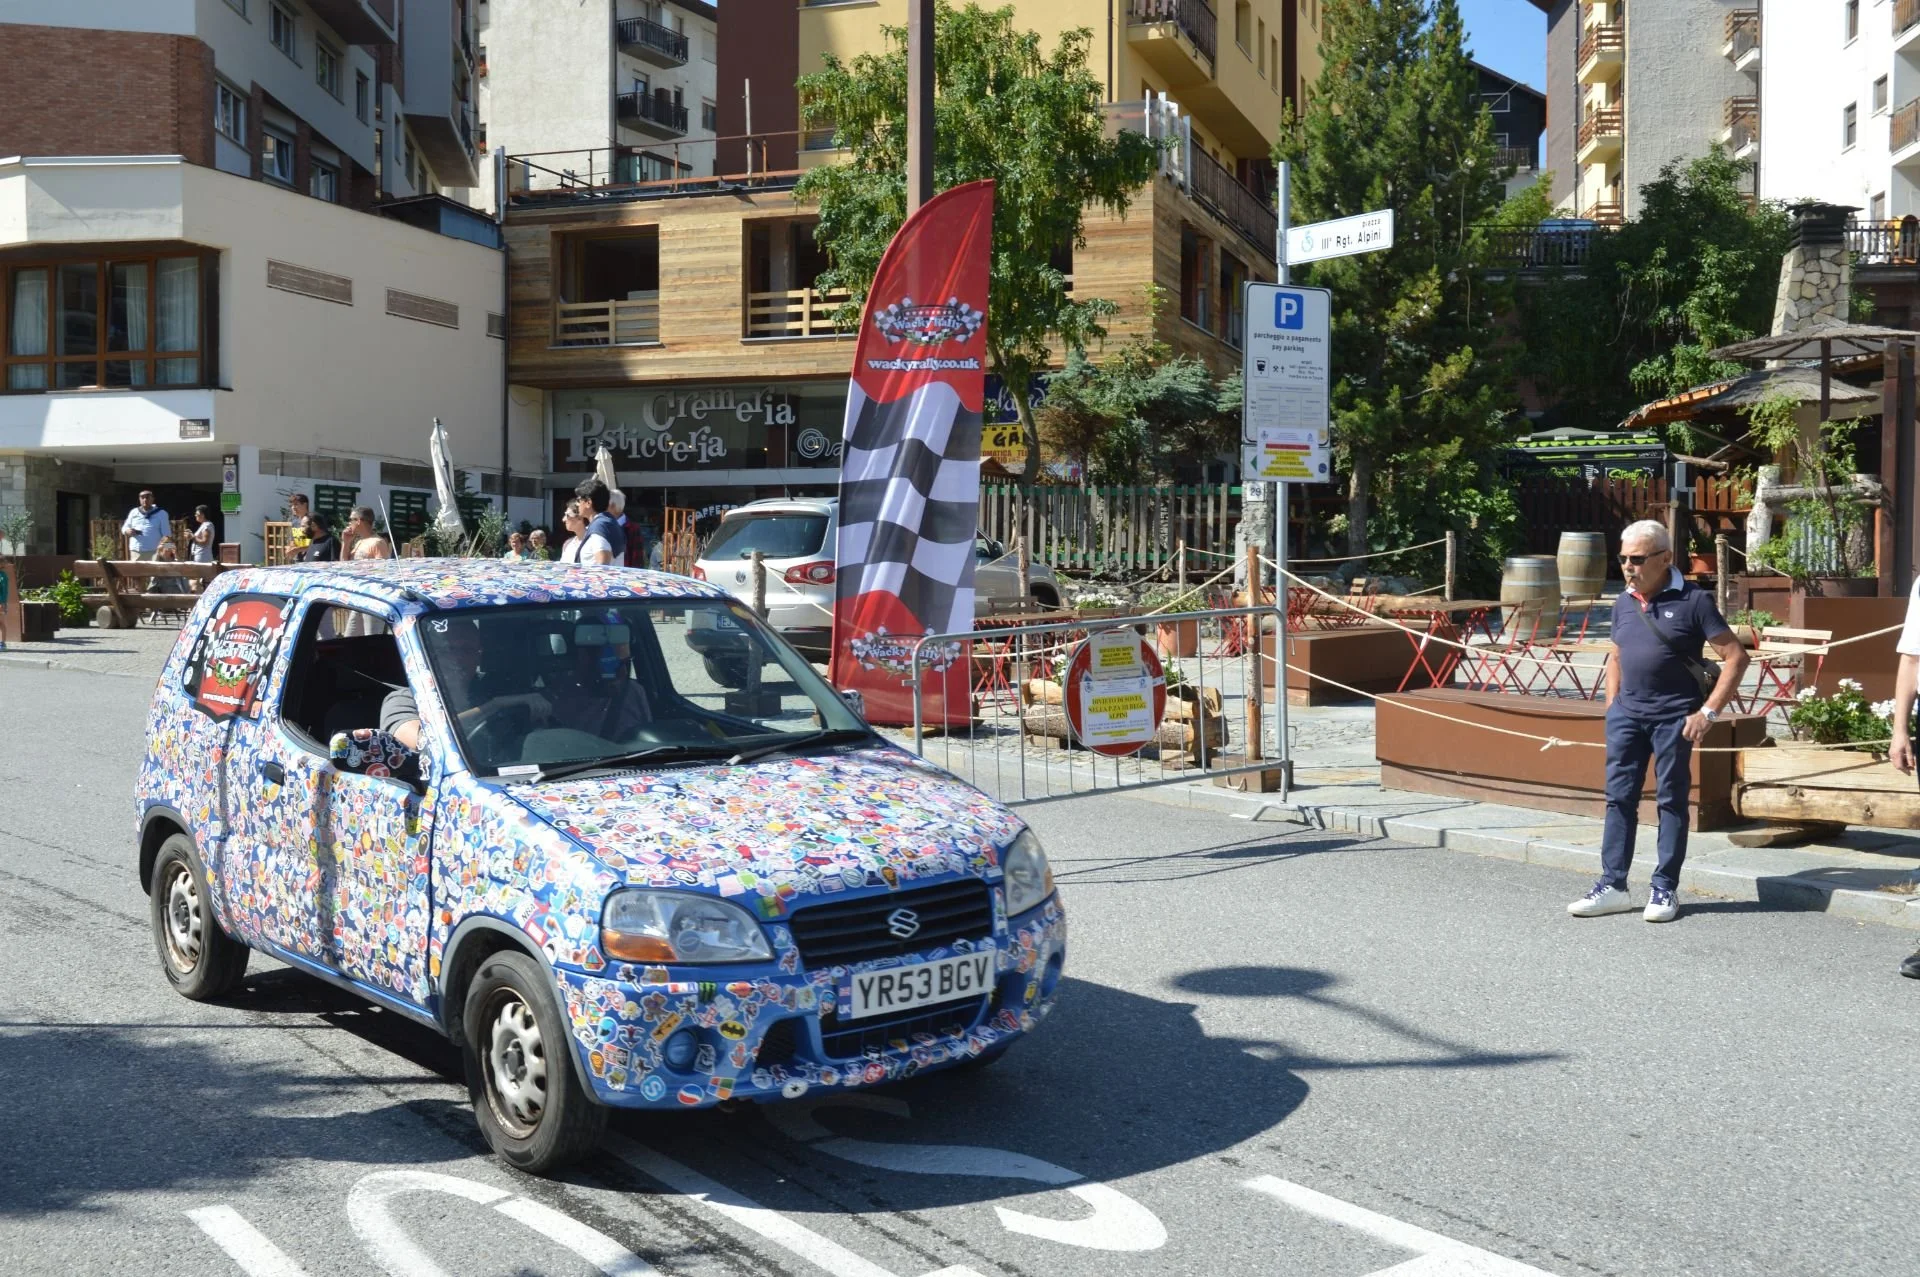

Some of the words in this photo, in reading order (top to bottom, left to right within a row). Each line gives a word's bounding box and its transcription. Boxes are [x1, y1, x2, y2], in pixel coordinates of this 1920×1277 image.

[1362, 219, 1381, 227] piazza
[1336, 234, 1353, 248] Rgt.
[1358, 228, 1381, 244] Alpini
[1280, 298, 1298, 324] P
[893, 317, 932, 330] Wacky
[933, 316, 962, 330] Rally
[1254, 332, 1285, 341] parcheggio
[1291, 335, 1322, 343] pagamento
[1272, 344, 1282, 352] pay
[1283, 345, 1305, 354] parking
[867, 357, 980, 372] wackyrally.co.uk
[642, 386, 796, 432] Cremeria
[566, 408, 727, 464] Pasticceria
[868, 645, 906, 659] Wacky
[858, 967, 932, 1010] YR53
[938, 956, 989, 996] BGV
[838, 1003, 850, 1014] UK
